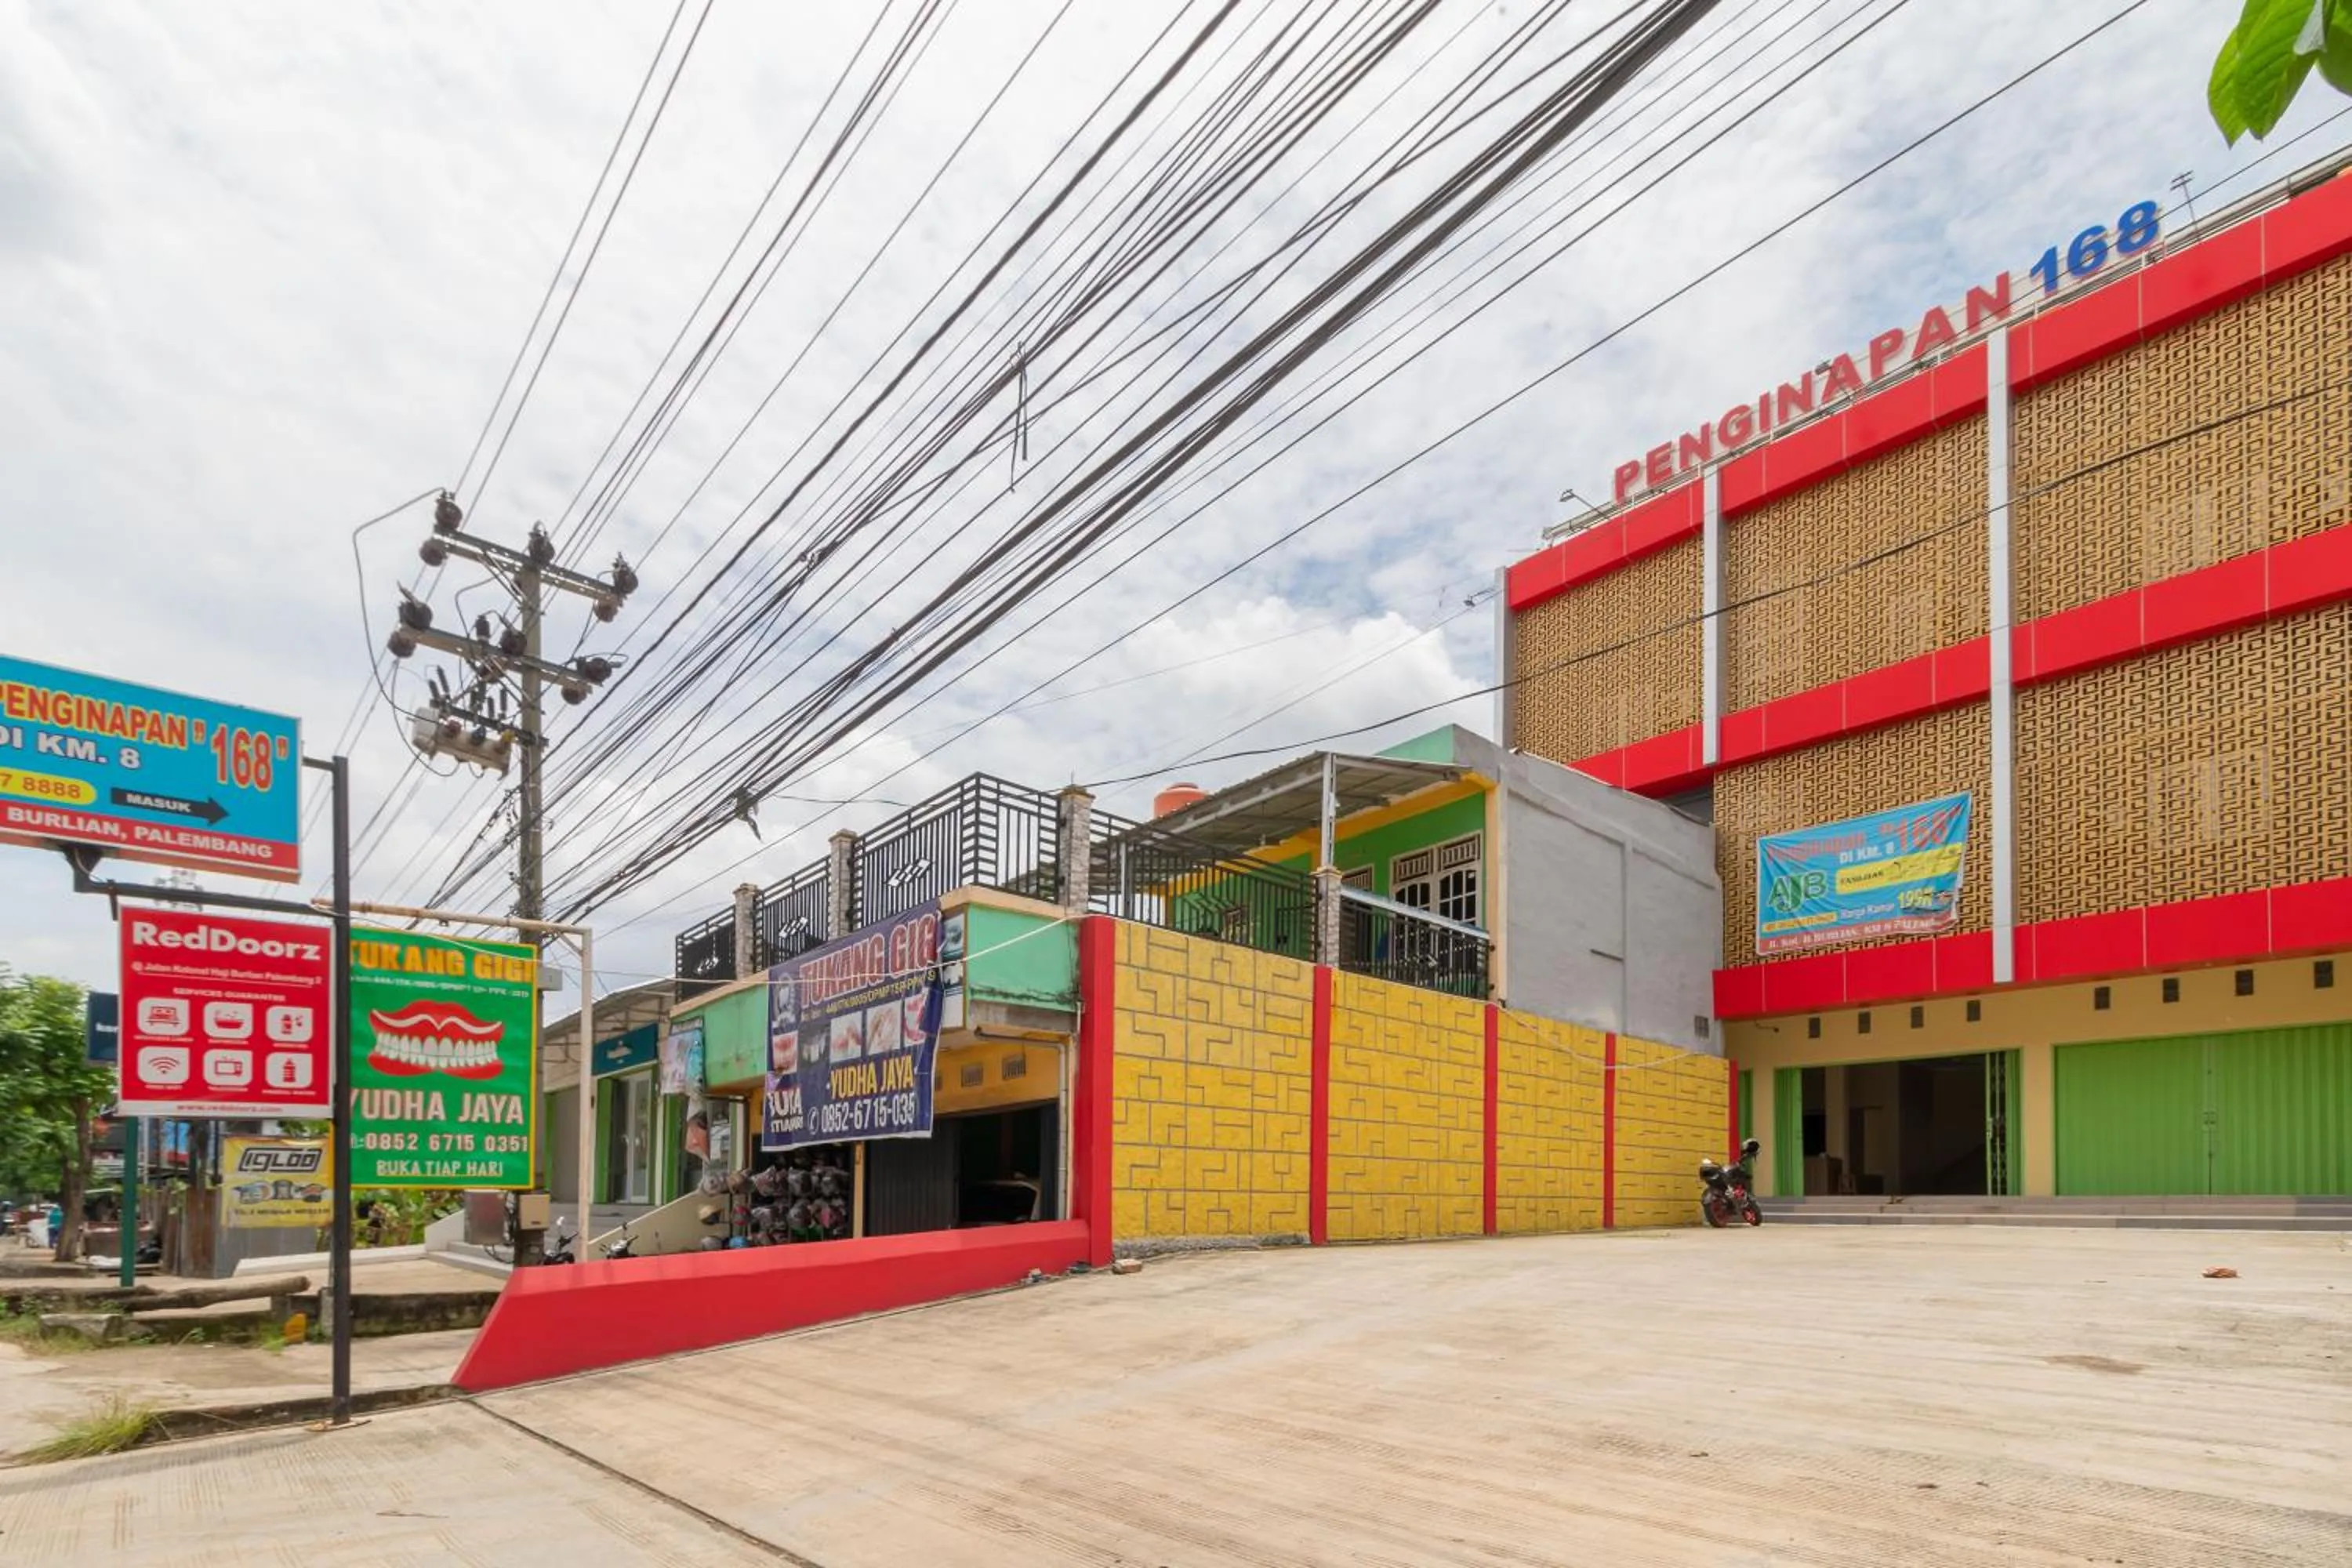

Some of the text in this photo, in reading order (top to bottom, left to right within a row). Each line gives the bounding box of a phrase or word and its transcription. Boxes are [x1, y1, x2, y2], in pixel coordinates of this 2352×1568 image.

[1613, 200, 2161, 506] PENGINAPAN 168
[0, 681, 187, 749] ENGINAPAN
[38, 731, 107, 764] KM.
[120, 748, 140, 769] 8
[22, 777, 81, 799] 8888
[126, 792, 191, 813] MASUK
[7, 807, 273, 858] BURLIAN, PALEMBANG
[132, 921, 321, 960] RedDoorz
[474, 952, 534, 982] GIGI
[799, 933, 885, 1009] TUKANG
[889, 912, 941, 978] GIG
[830, 1054, 914, 1099] YUDHA JAYA
[458, 1093, 524, 1123] JAYA
[430, 1134, 474, 1152] 6715
[485, 1136, 528, 1152] 0351
[376, 1160, 503, 1177] BUKA TIAP HARI
